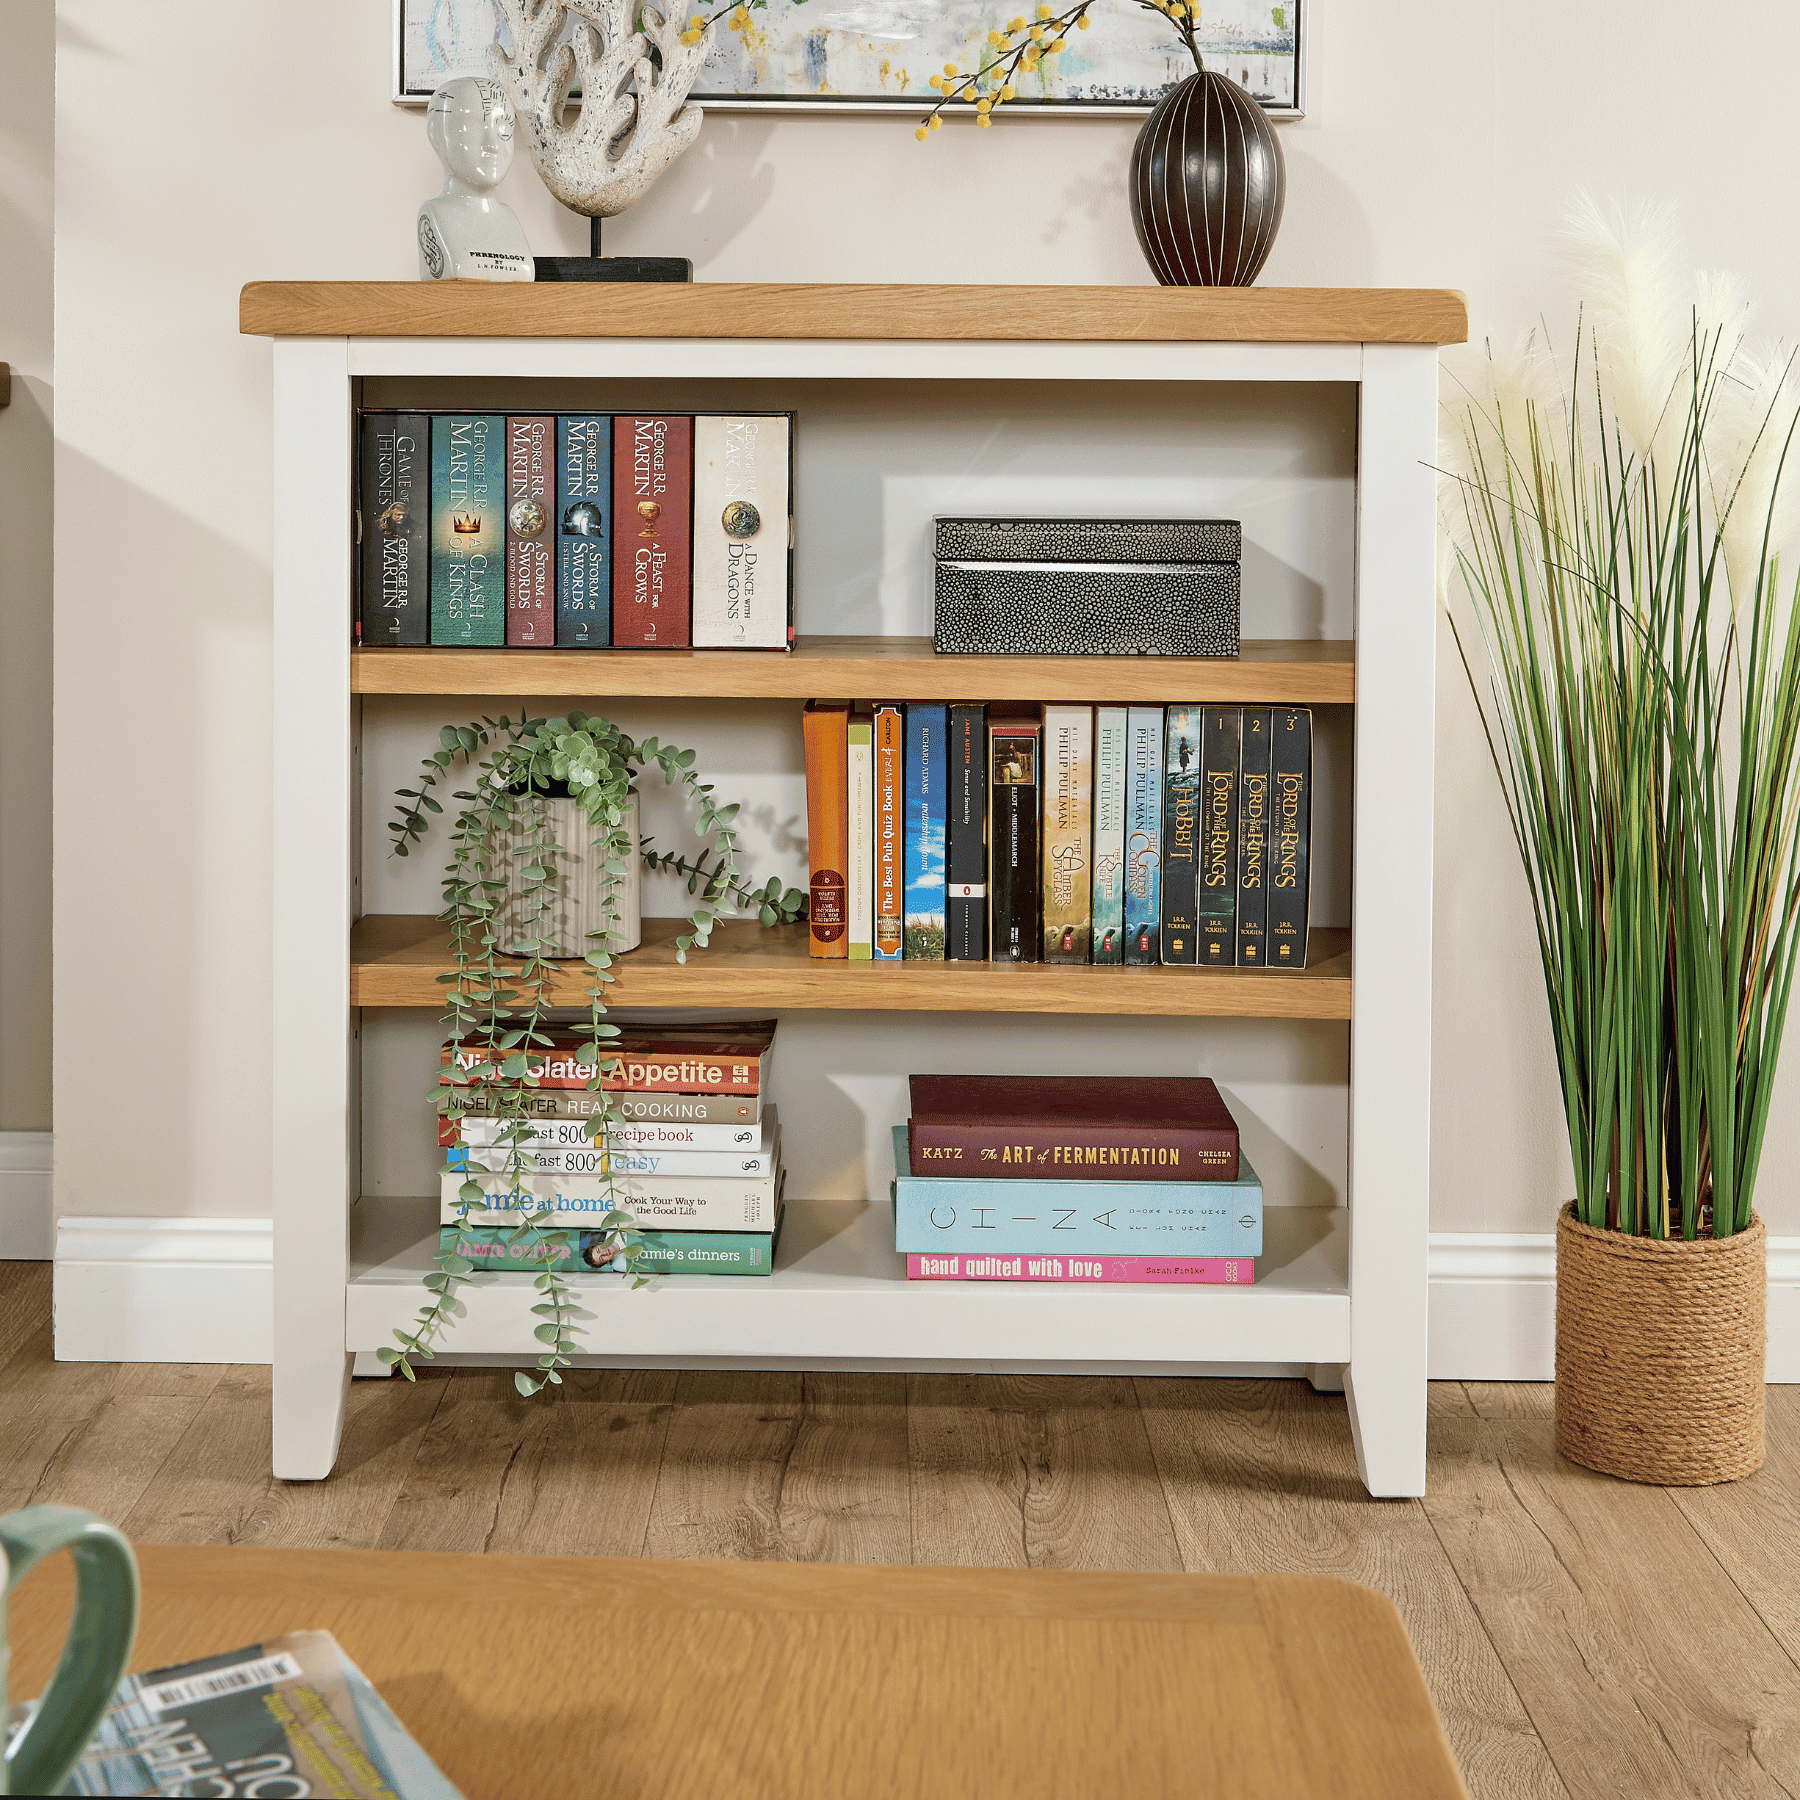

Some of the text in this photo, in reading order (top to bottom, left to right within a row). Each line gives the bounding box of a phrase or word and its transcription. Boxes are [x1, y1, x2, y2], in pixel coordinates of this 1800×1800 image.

[469, 252, 525, 261] PHRENOLOGY
[377, 432, 395, 506] THRONES
[396, 436, 416, 502] GAME OF
[450, 421, 472, 514] MARTIN
[473, 421, 488, 514] GEORGE R.R.
[512, 422, 532, 499] MARTIN
[532, 423, 546, 473] GEORGE
[567, 420, 586, 497] MARTIN
[586, 421, 600, 472] GEORGE
[634, 420, 654, 496] MARTIN
[654, 420, 668, 471] GEORGE
[725, 422, 745, 498] MARTIN
[745, 423, 758, 473] GEORGE
[397, 538, 408, 587] GEORGE
[652, 542, 660, 550] A
[383, 538, 398, 609] MARTIN
[449, 536, 466, 620] OF KINGS
[468, 536, 488, 619] A CLASH
[518, 542, 535, 609] SWORDS
[535, 551, 548, 596] STORM
[572, 542, 588, 610] SWORDS
[588, 542, 602, 610] A STORM OF
[635, 549, 652, 604] CROWS
[652, 552, 668, 592] FEAST
[728, 542, 744, 620] DRAGONS
[744, 552, 758, 596] DANCE
[536, 599, 542, 609] OF
[922, 727, 930, 765] RICHARD
[1218, 718, 1223, 730] 1
[1252, 720, 1260, 732] 2
[1286, 719, 1295, 731] 3
[1058, 727, 1068, 830] PHILIP PULLMAN
[1100, 728, 1112, 832] PHILIP PULLMAN
[1134, 728, 1146, 830] PHILIP PULLMAN
[1207, 770, 1234, 816] LORD
[1244, 772, 1268, 818] LORD
[1276, 771, 1304, 817] LORD
[880, 747, 897, 911] The Best Pub Quiz Book EVER! 4
[963, 797, 971, 824] Sensibility
[1170, 787, 1194, 863] HOBBIT
[922, 846, 930, 870] down
[1052, 845, 1074, 905] SPYGLASS
[1060, 836, 1085, 911] THE AMBER
[1096, 852, 1115, 884] KNIFE
[1106, 862, 1122, 898] SUBTLE
[1129, 832, 1150, 893] COMPASS
[1136, 832, 1160, 899] THE GOLDEN
[1204, 829, 1230, 886] RINGS
[1241, 832, 1264, 888] RINGS
[1274, 830, 1300, 888] RINGS
[608, 1058, 723, 1087] Appetite
[622, 1102, 707, 1118] COOKING
[658, 1128, 694, 1142] book
[565, 1153, 661, 1174] 800 easy
[922, 1146, 1180, 1166] KATZ The ART of FERMENTATION
[1198, 1150, 1232, 1158] CHELSEA
[537, 1194, 617, 1212] at home
[624, 1196, 706, 1207] Cook Your Way to
[636, 1206, 697, 1216] the Good Life
[930, 1206, 1118, 1230] CHINA
[688, 1248, 740, 1262] dinners
[920, 1256, 1103, 1278] hand quilted with love
[1146, 1266, 1172, 1275] Sarah
